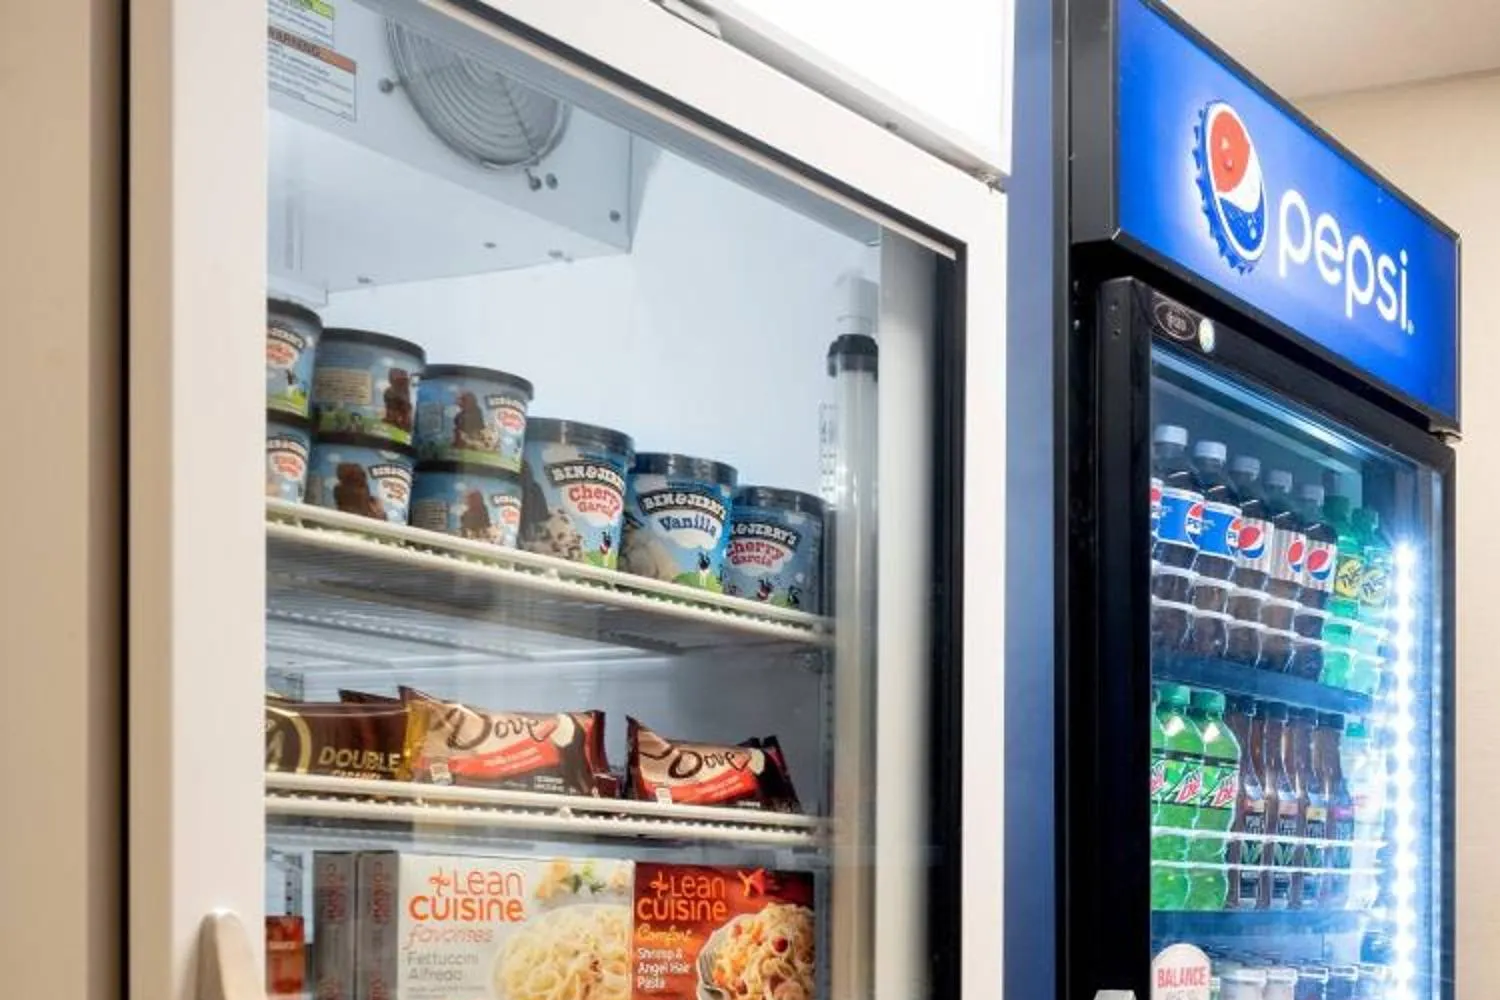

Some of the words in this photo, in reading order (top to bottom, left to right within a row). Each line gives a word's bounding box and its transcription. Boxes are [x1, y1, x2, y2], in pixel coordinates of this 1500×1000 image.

[1279, 189, 1408, 332] pepsi
[658, 515, 717, 539] Vanilla
[448, 703, 553, 750] Dove
[318, 745, 401, 770] DOUBLE
[669, 748, 752, 779] Dove
[453, 867, 525, 897] Lean
[671, 875, 726, 899] Lean
[406, 952, 479, 967] Fettuccini
[637, 962, 669, 979] Angel
[406, 967, 464, 982] Alfredo
[637, 975, 665, 990] Pasta
[1158, 966, 1207, 988] BALANCE
